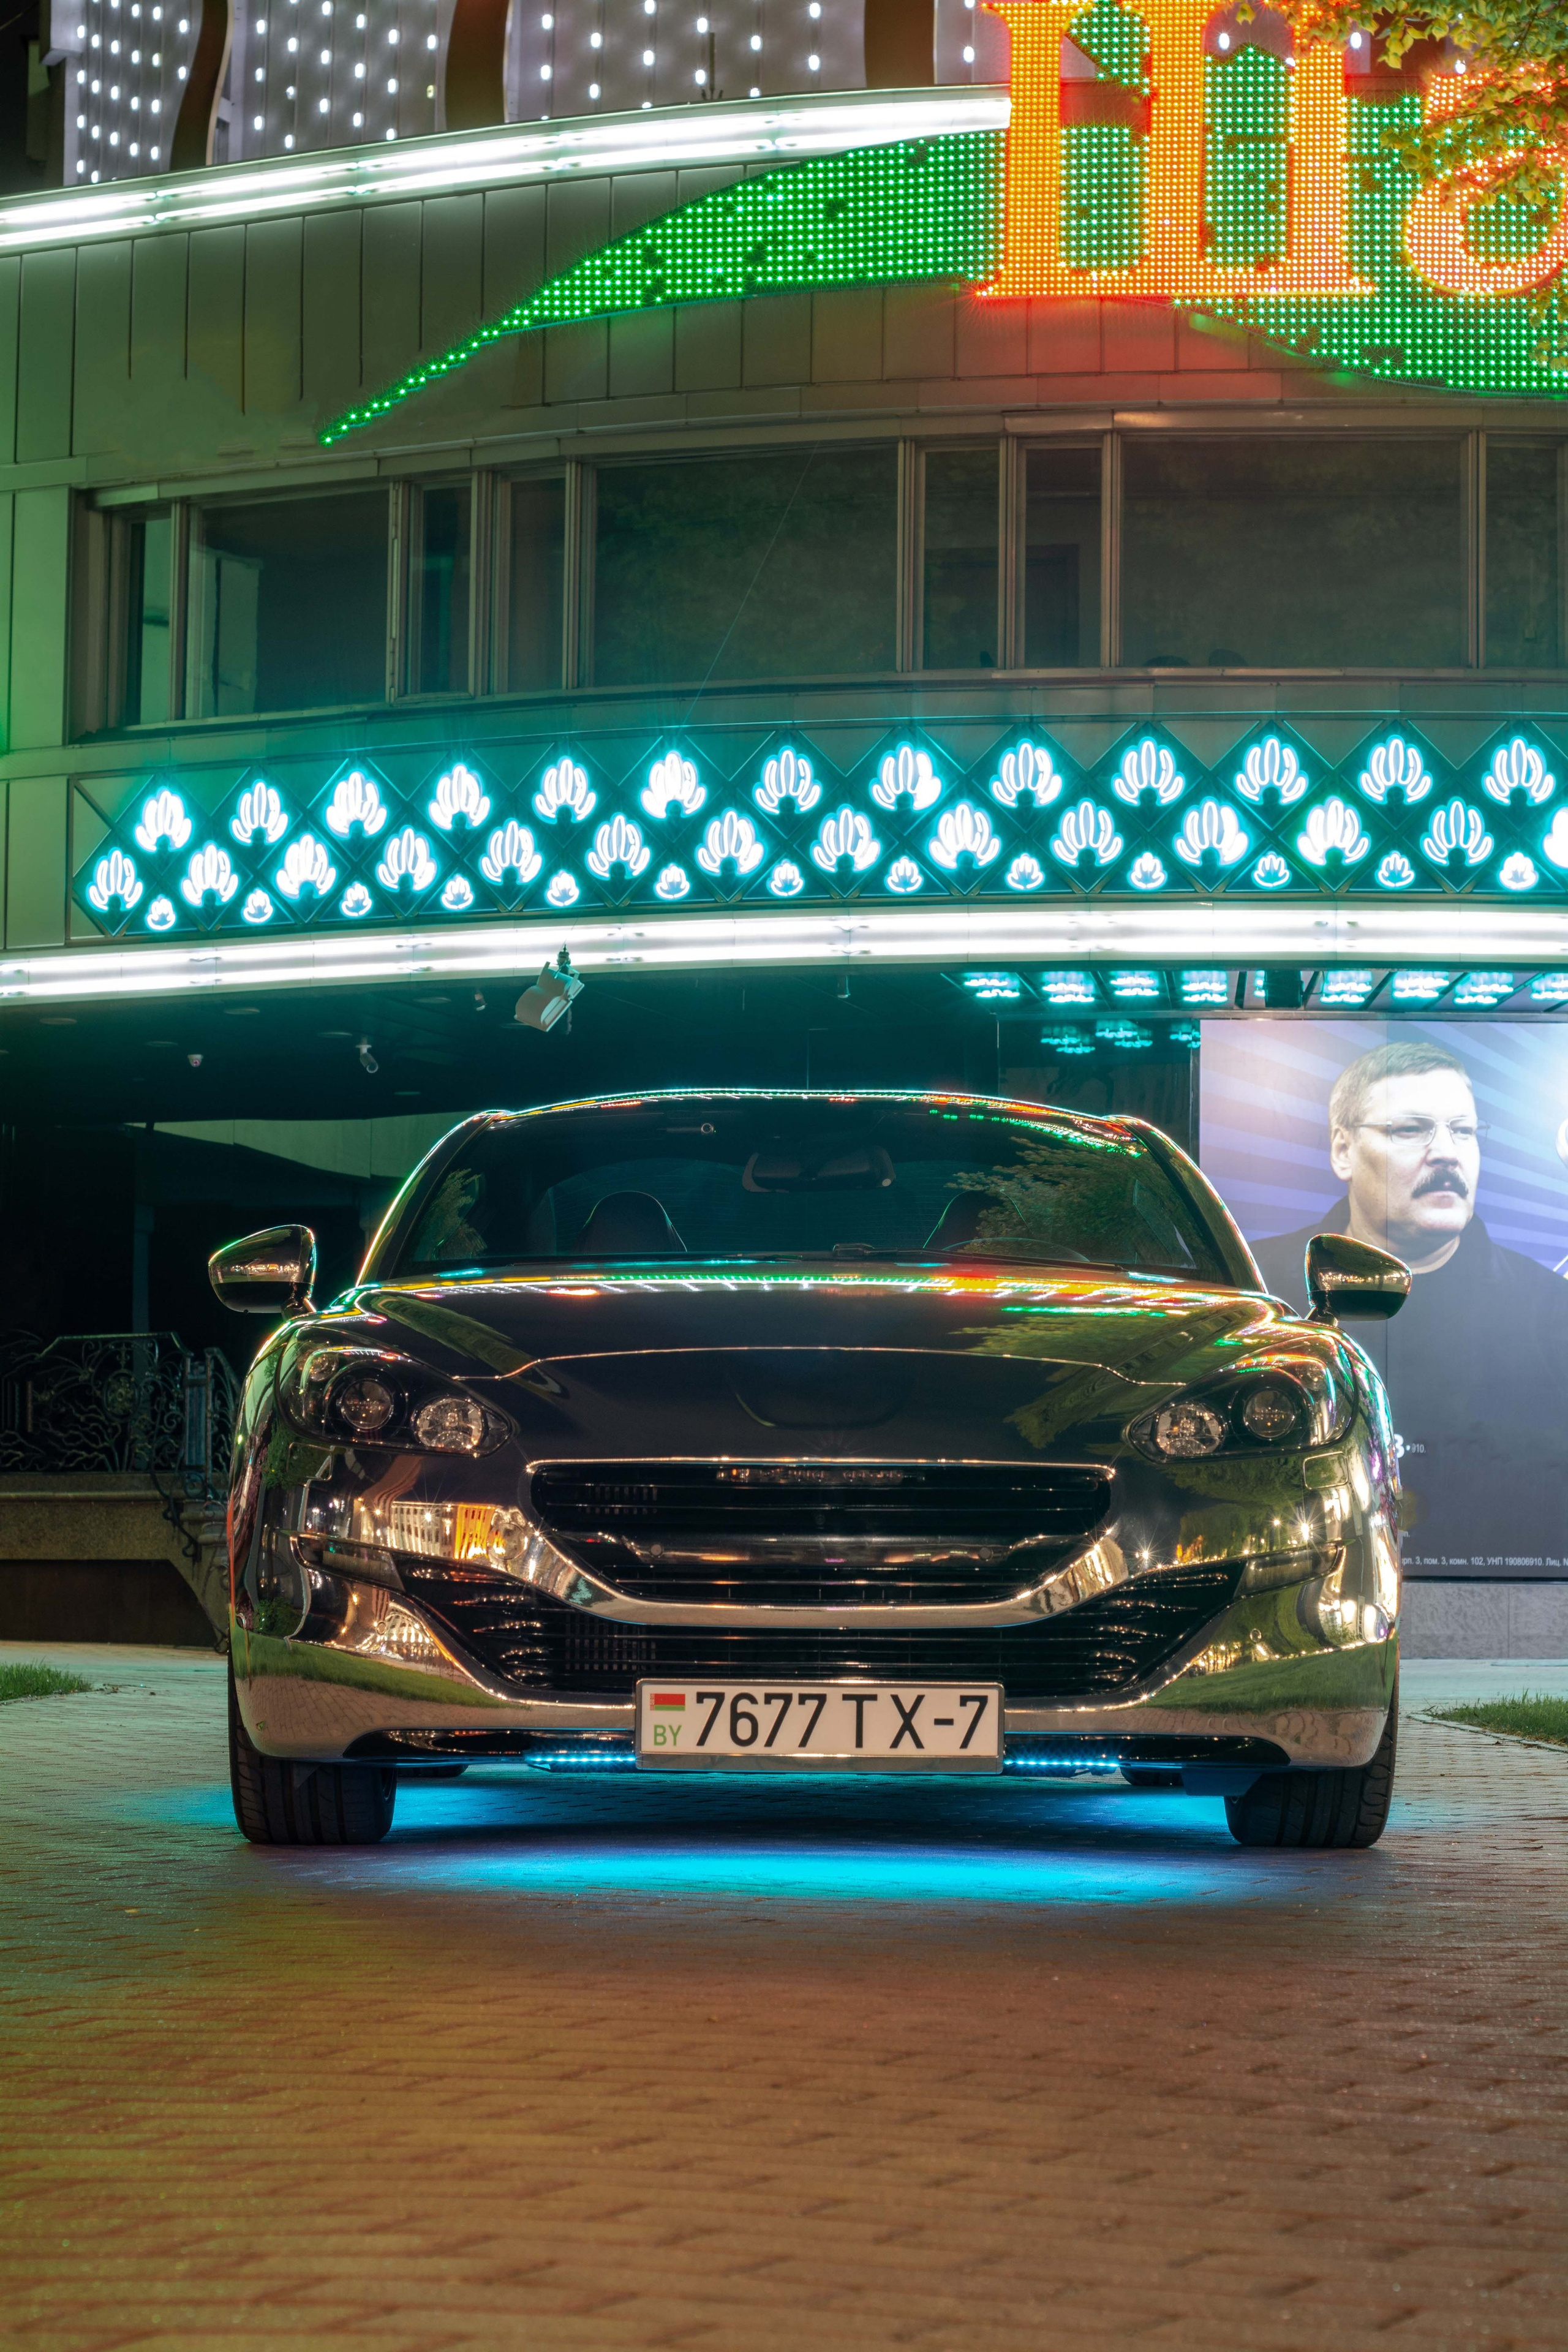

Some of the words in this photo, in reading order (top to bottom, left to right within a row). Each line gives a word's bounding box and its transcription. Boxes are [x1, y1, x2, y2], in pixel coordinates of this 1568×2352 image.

[1471, 1556, 1485, 1566] 102,
[1487, 1556, 1503, 1566] УНП
[696, 1692, 827, 1747] 7677
[654, 1724, 682, 1746] BY
